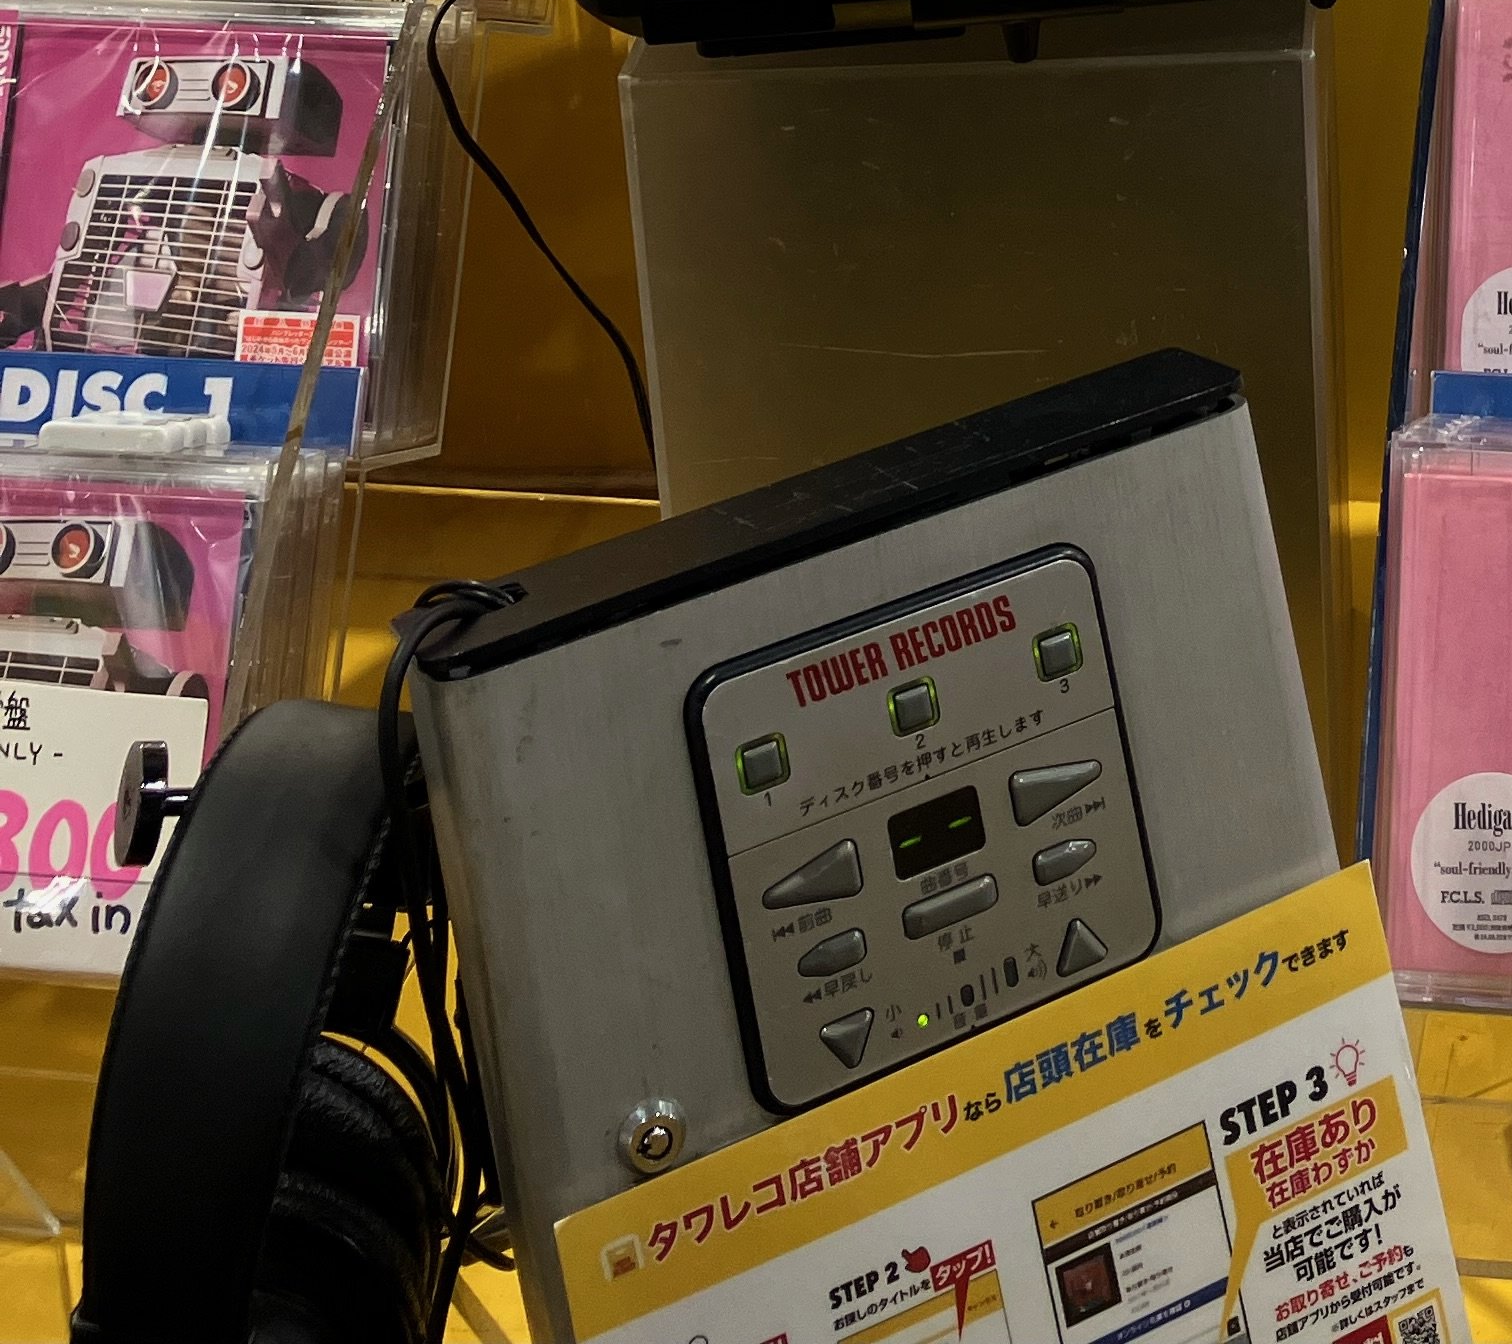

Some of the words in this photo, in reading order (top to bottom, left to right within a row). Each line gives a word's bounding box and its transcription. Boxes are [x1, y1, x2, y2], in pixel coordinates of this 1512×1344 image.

[2, 366, 168, 415] DISC
[204, 376, 233, 414] 1
[786, 641, 888, 708] TOWER
[889, 594, 1017, 671] RECORDS
[1059, 678, 1071, 694] 3
[914, 734, 926, 749] 2
[763, 792, 773, 808] 1
[91, 891, 132, 935] in
[1219, 1080, 1298, 1146] STEP
[1305, 1065, 1329, 1103] 3
[1249, 1096, 1378, 1185] 在庫あり
[1266, 1137, 1376, 1210] 在庫わずか
[1263, 1183, 1402, 1274] 当店でご購入が
[1272, 1171, 1386, 1240] と表示されていれば
[1292, 1222, 1383, 1283] 可能です!
[828, 1273, 880, 1310] STEP
[884, 1262, 901, 1286] 2
